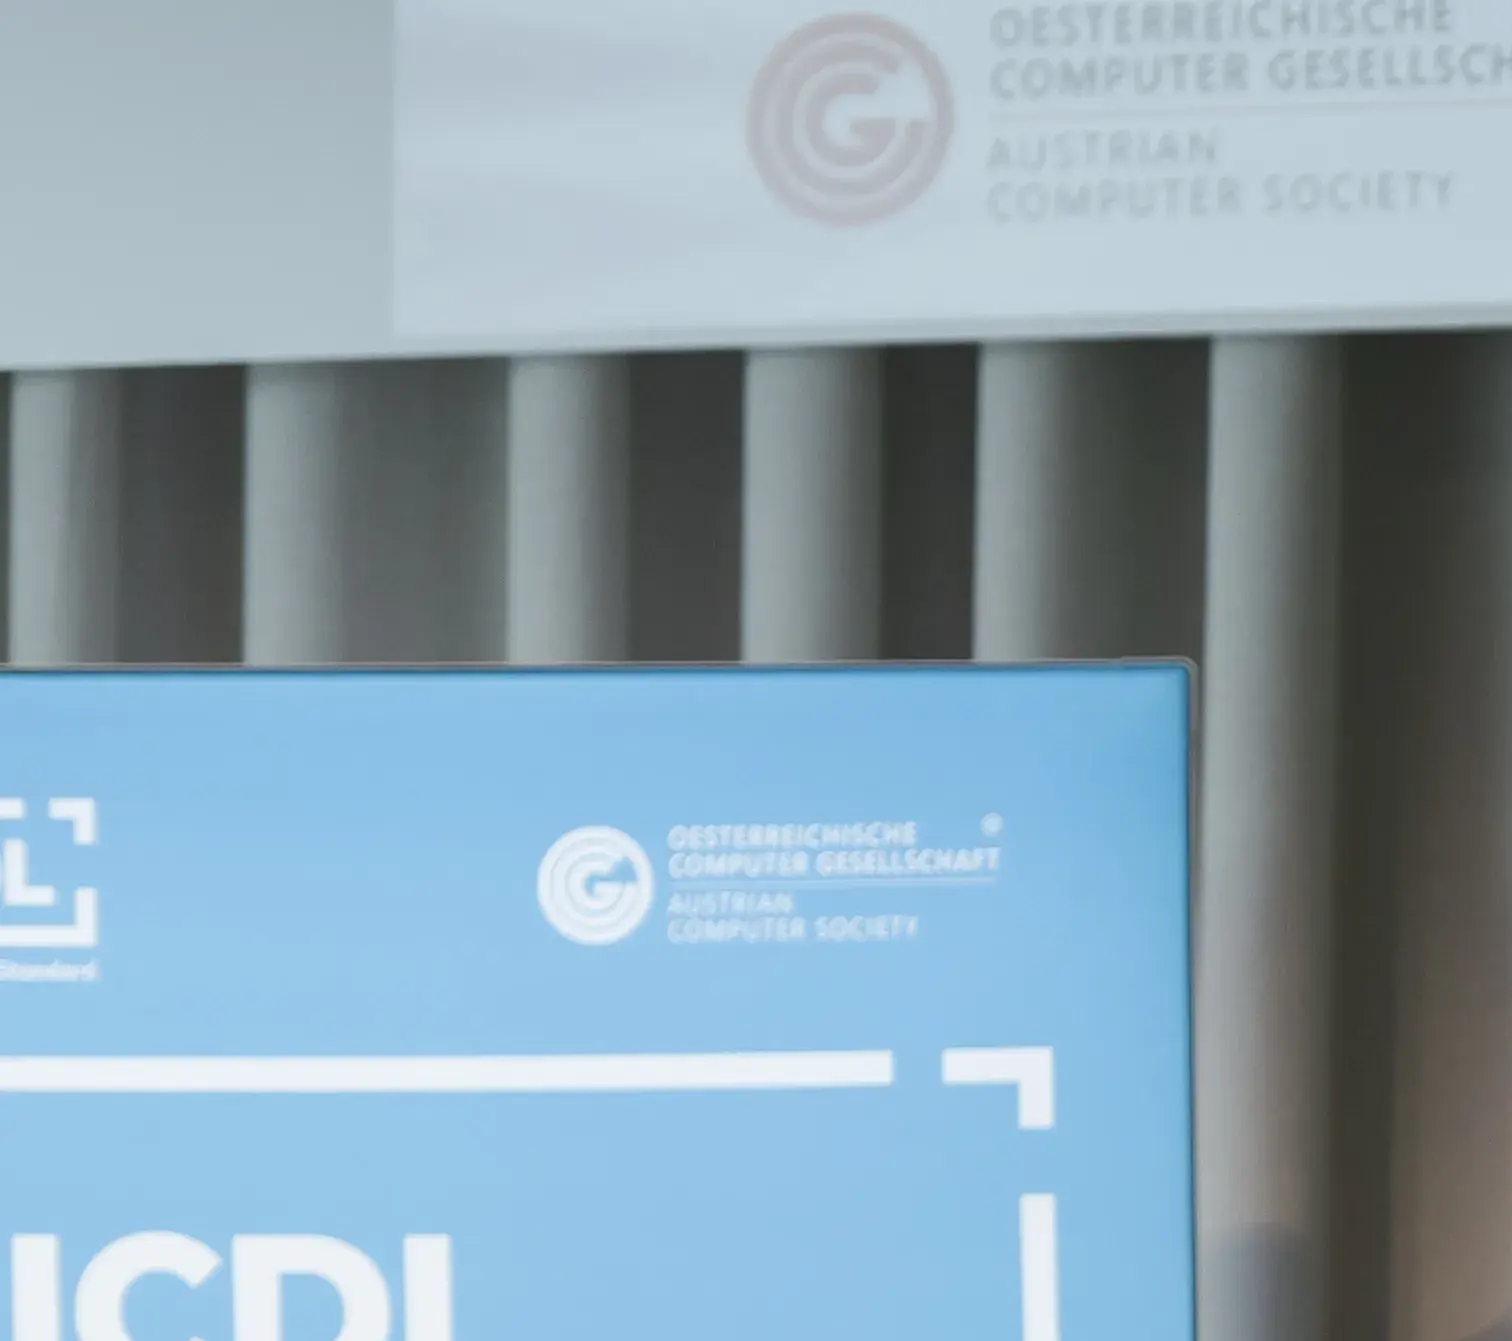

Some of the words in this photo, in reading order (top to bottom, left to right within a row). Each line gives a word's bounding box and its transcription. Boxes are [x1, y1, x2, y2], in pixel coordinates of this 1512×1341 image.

[990, 0, 1454, 47] OESTERREICHISCHE
[988, 53, 1248, 102] COMPUTER
[987, 127, 1219, 174] AUSTRIAN
[986, 176, 1246, 224] COMPUTER
[1262, 168, 1457, 216] SOCIETY
[667, 821, 917, 850] OESTERREICHISCHE
[668, 852, 808, 879] COMPUTER
[816, 847, 1001, 877] GESELLSCHAFT
[668, 892, 793, 915] AUSTRIAN
[667, 918, 806, 944] COMPUTER
[816, 914, 919, 942] SOCIETY
